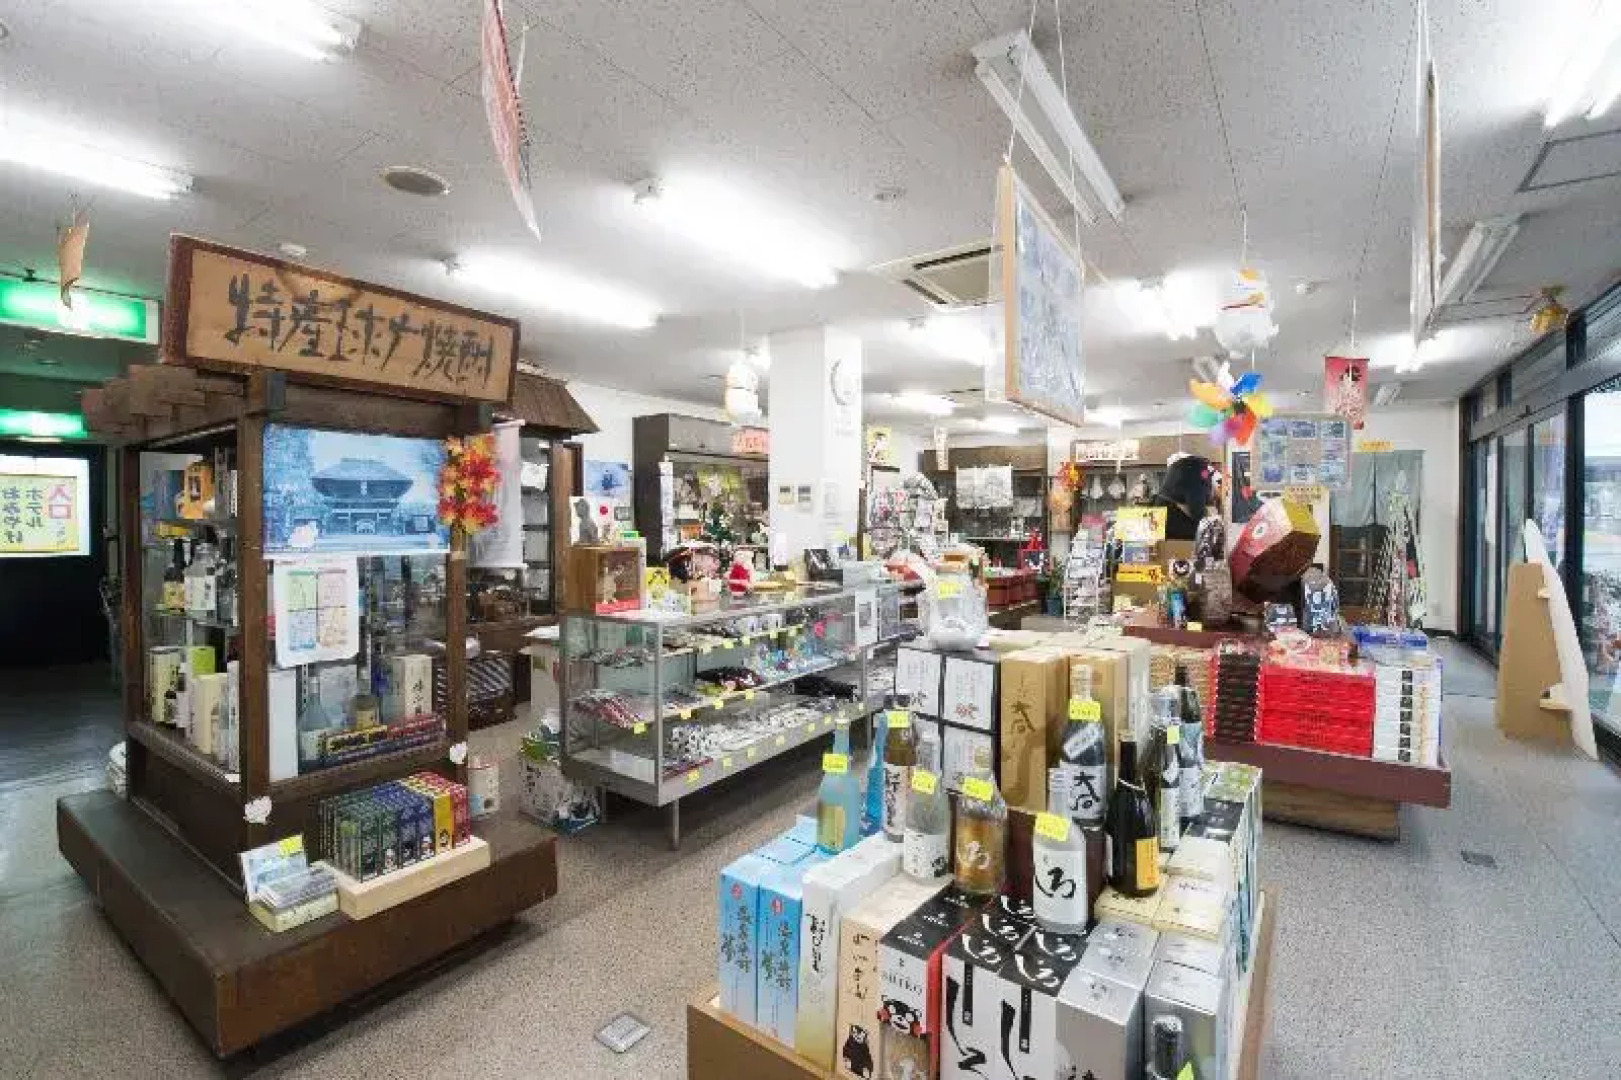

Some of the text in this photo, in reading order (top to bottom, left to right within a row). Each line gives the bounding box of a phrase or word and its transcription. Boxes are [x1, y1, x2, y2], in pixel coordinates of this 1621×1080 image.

[26, 487, 43, 527] ホテル
[48, 484, 71, 519] 入口
[1035, 866, 1076, 899] しろ
